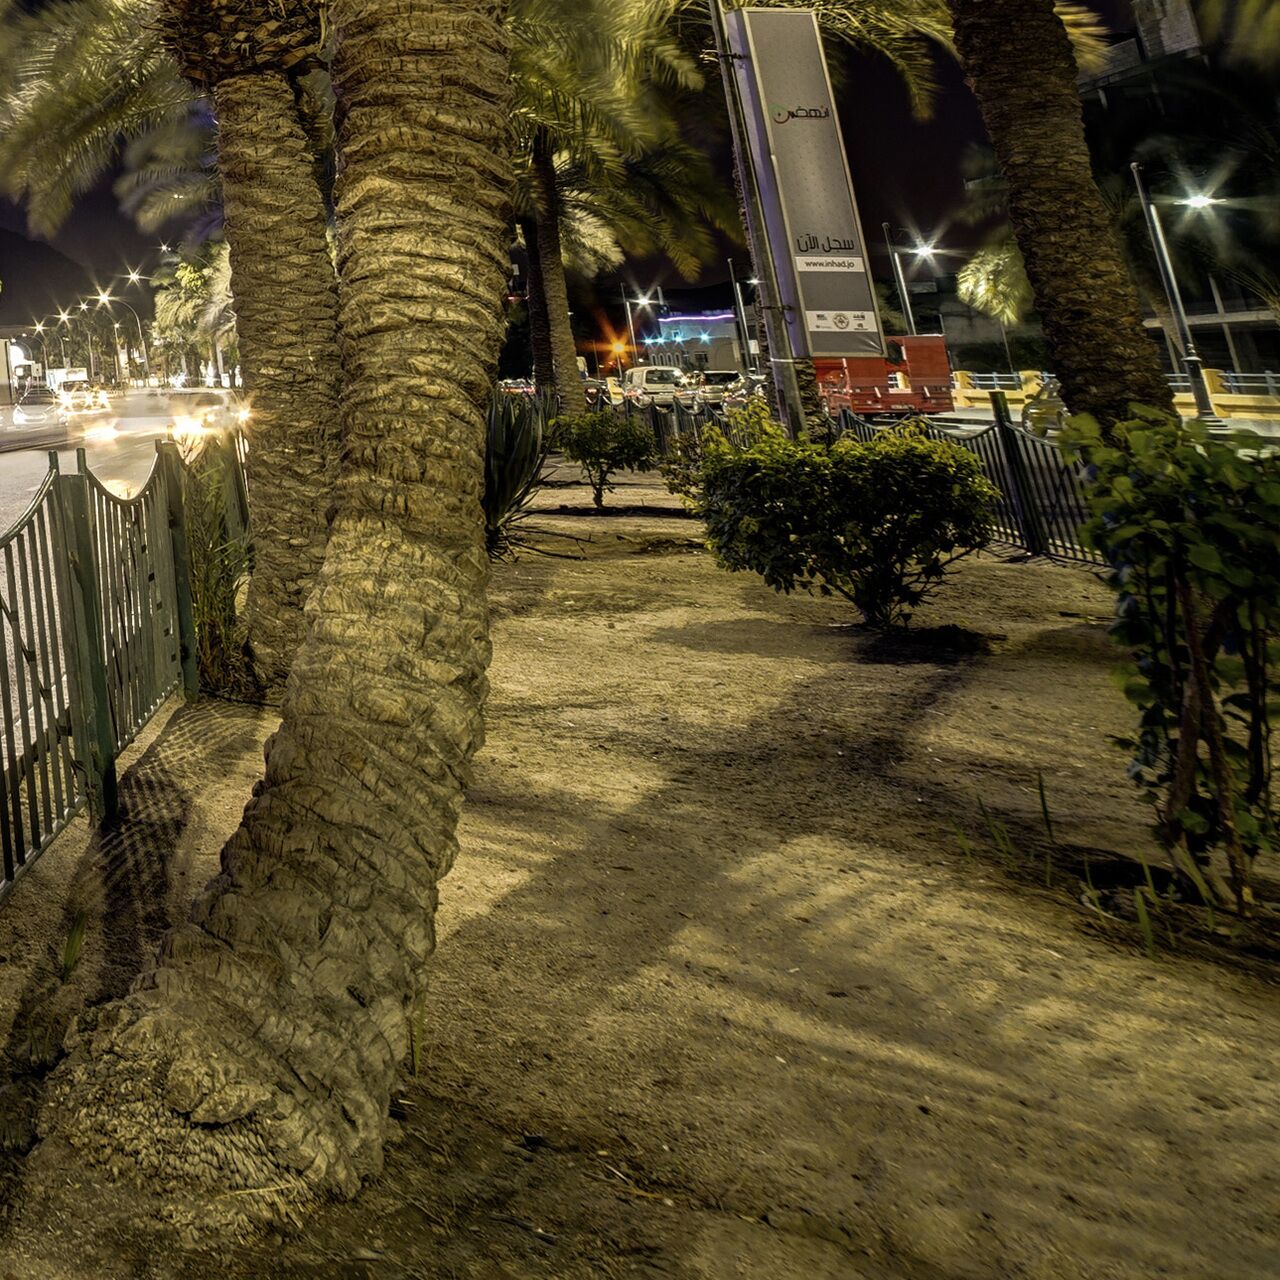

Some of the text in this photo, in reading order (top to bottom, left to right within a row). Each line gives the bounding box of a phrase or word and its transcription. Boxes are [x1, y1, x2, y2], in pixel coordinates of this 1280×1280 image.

[796, 233, 855, 253] سجل الآن
[804, 260, 855, 270] www.inhad.jo
